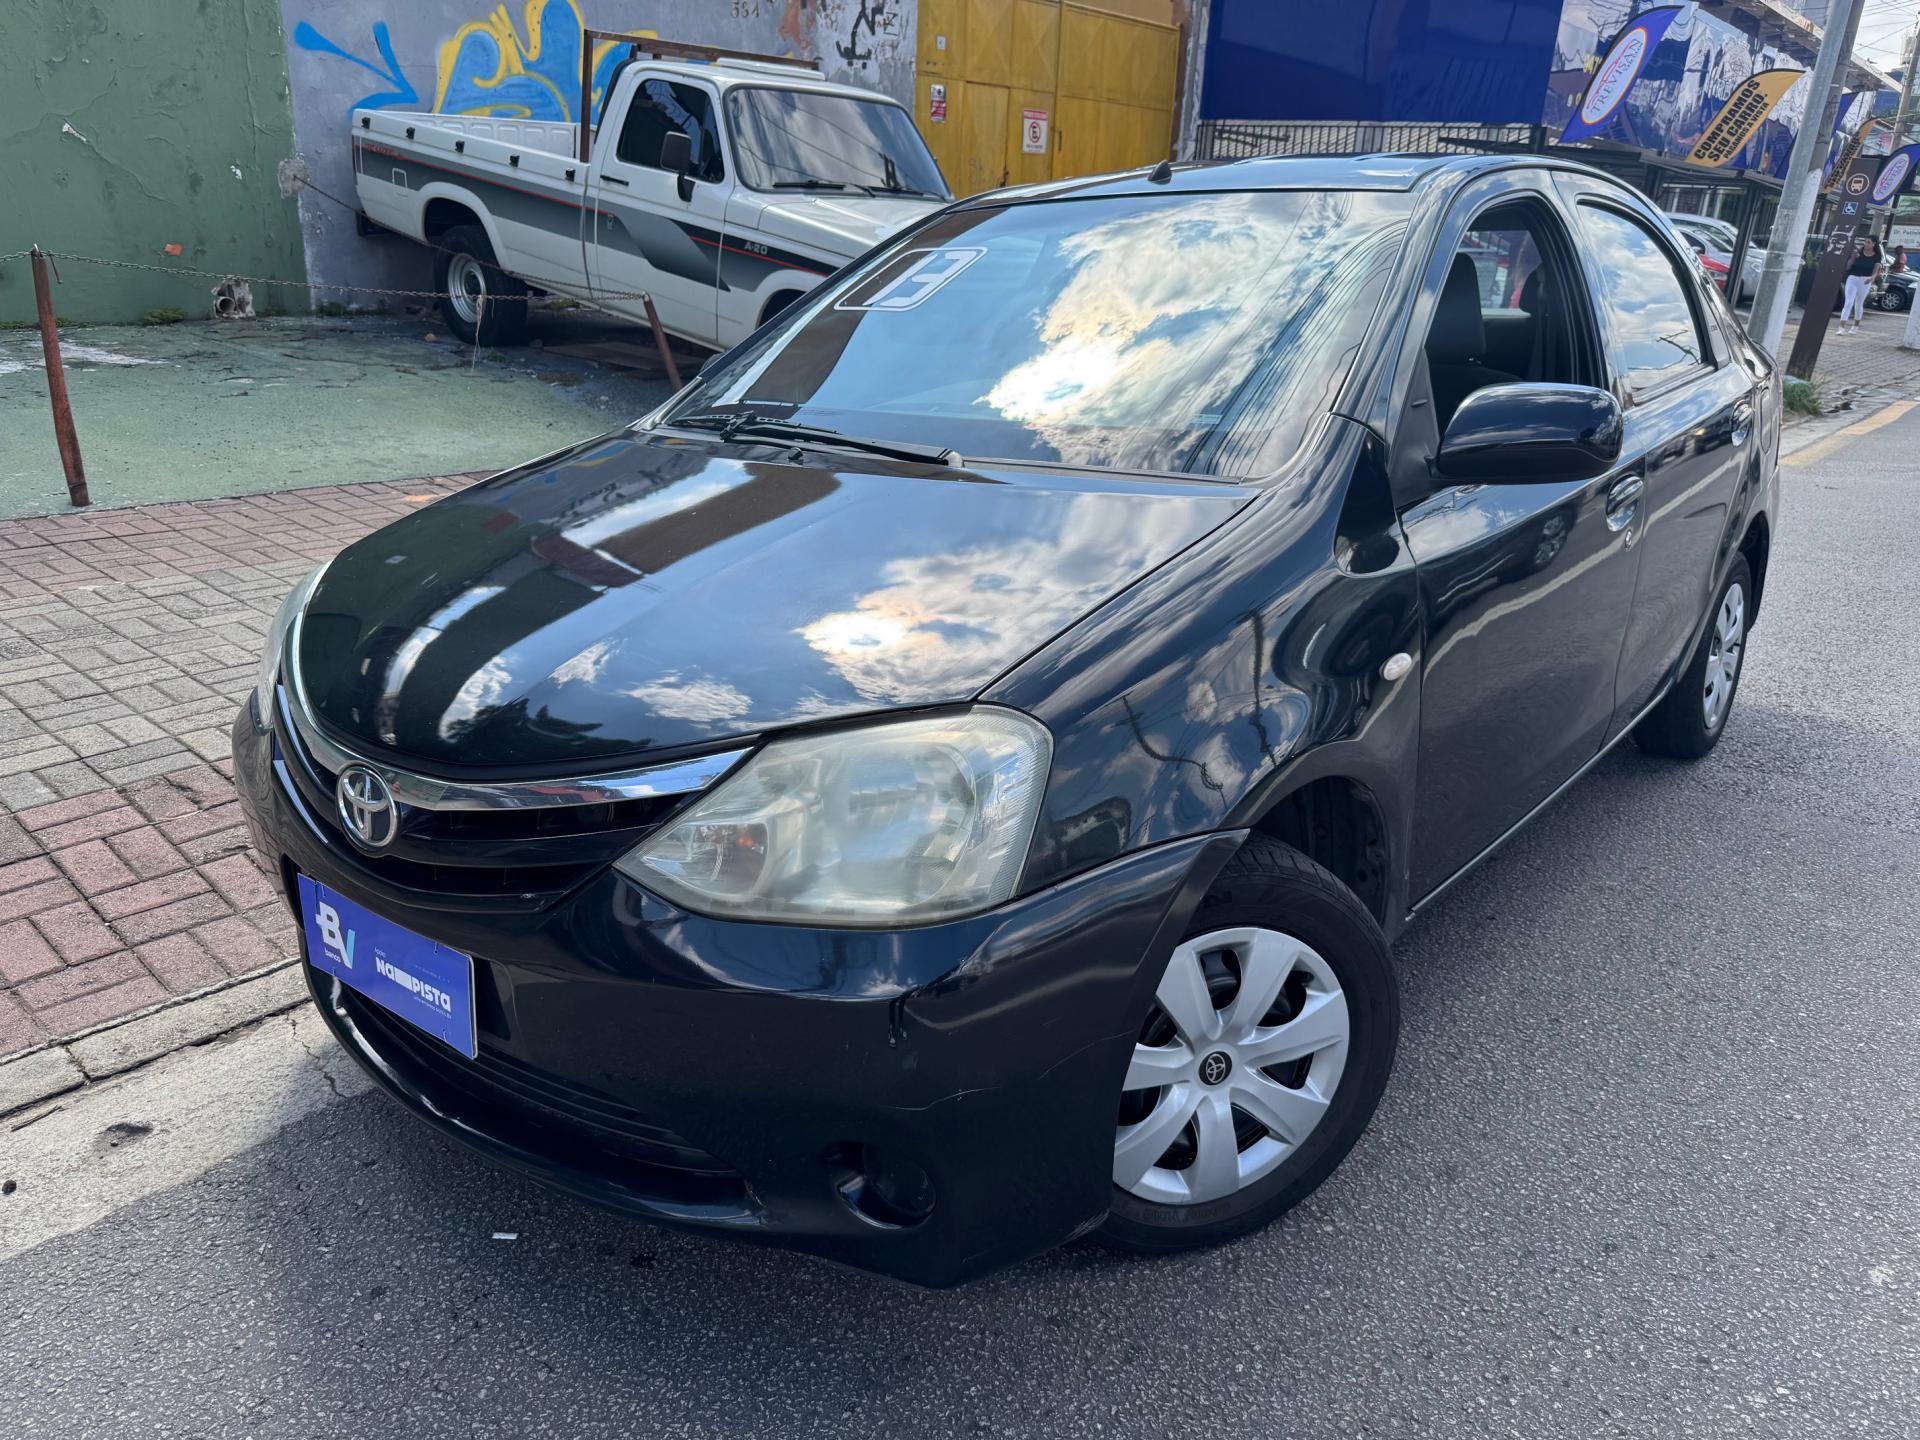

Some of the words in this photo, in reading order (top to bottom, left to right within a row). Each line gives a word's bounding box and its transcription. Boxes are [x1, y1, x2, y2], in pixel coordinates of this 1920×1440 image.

[1591, 39, 1642, 113] TREVISAN
[1694, 80, 1760, 159] COMPRAMOS
[1707, 136, 1731, 162] SEU
[1727, 93, 1768, 137] CARRO.
[1723, 126, 1749, 159] PAGAMOS
[1751, 102, 1769, 122] VISTA
[744, 241, 768, 255] A-20
[325, 947, 341, 963] banco
